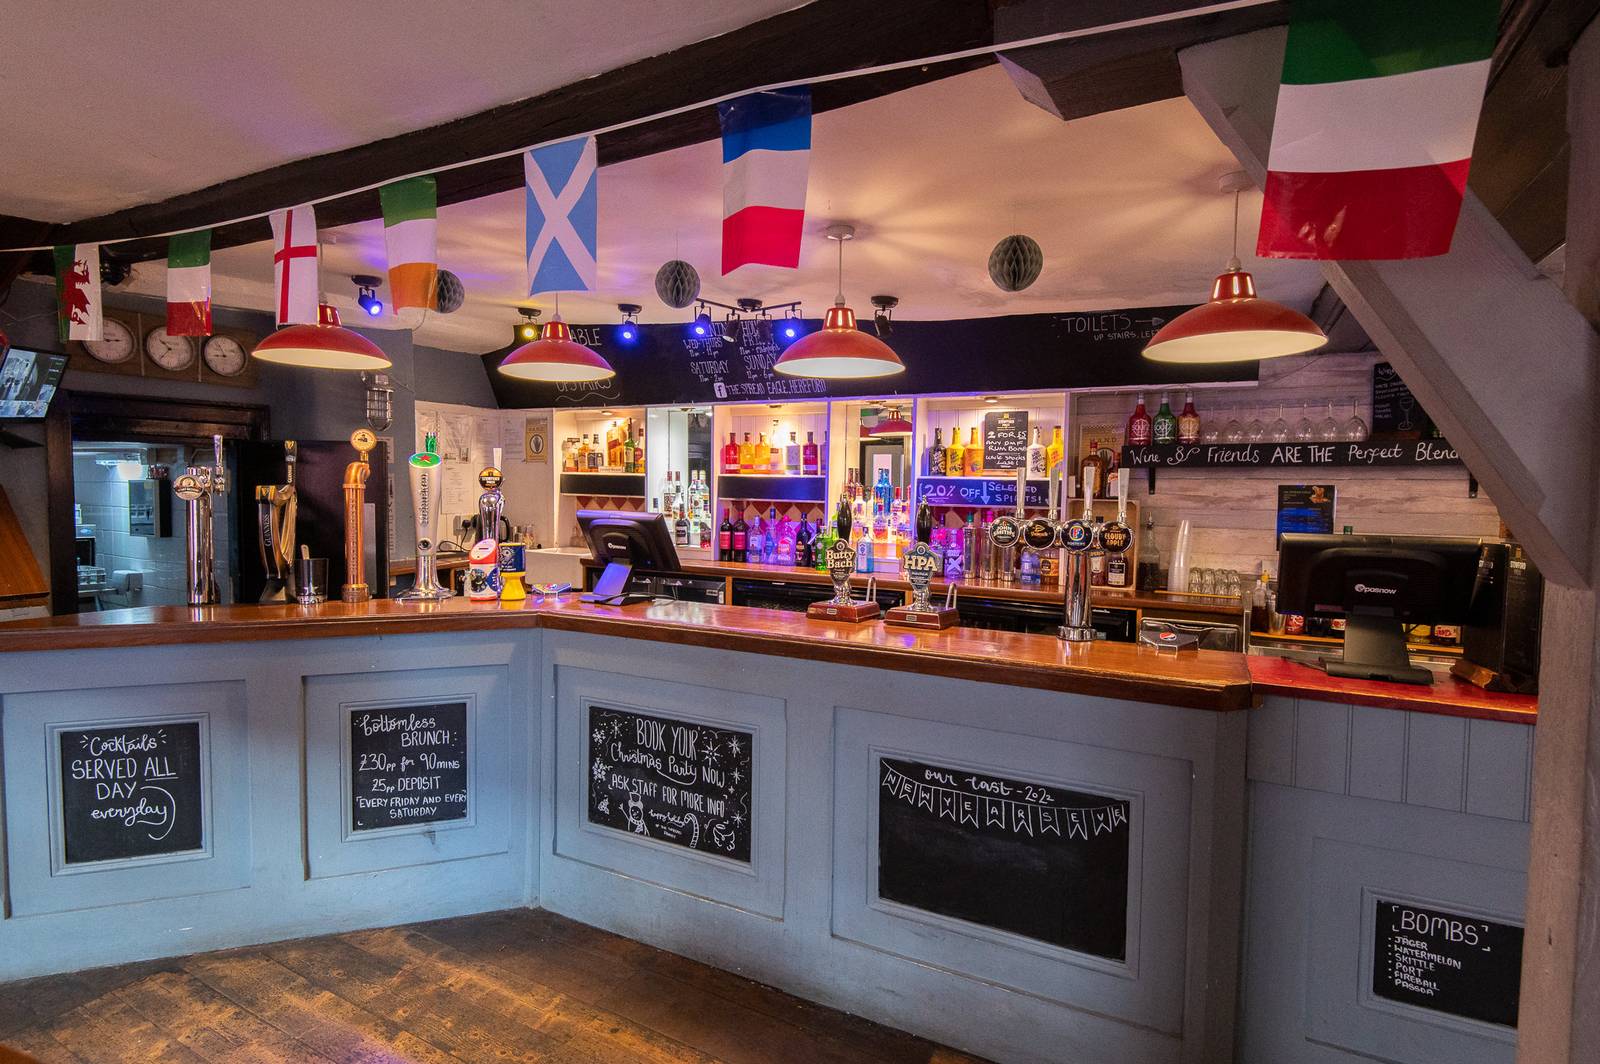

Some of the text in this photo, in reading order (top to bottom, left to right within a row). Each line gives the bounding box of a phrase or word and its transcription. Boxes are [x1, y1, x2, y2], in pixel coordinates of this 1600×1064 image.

[1061, 314, 1132, 333] TOILETS
[690, 360, 729, 374] SATURDAY
[744, 353, 777, 370] SUNDAY
[726, 384, 740, 395] THE
[740, 382, 765, 395] SPREAD
[789, 379, 826, 394] HEREFORD
[988, 431, 996, 439] 2
[1130, 450, 1160, 465] Wine
[1207, 444, 1260, 463] Friends
[1271, 446, 1302, 463] ARE
[1307, 445, 1335, 463] THE
[1348, 443, 1402, 464] Perfect
[925, 484, 980, 499] 20% OFF
[826, 549, 855, 560] Butty
[903, 555, 938, 571] HPA
[826, 558, 854, 569] Bach
[90, 734, 157, 756] Cocktails
[401, 730, 450, 747] BRUNCH
[636, 718, 698, 761] BOOK YOUR
[71, 757, 177, 779] SERVED ALL
[400, 756, 415, 772] for
[610, 741, 725, 788] Christmas Party NOW
[398, 775, 441, 792] DEPOSIT
[924, 769, 957, 786] our
[96, 781, 137, 800] DAY
[612, 773, 725, 818] ASK STAFF FOR MORE INFO
[359, 793, 467, 808] EVERY FRIDAY AND EVERY
[91, 797, 168, 827] everyday
[389, 806, 438, 819] SATURDAY
[1401, 910, 1479, 946] BOMBS
[1394, 944, 1462, 970] WATERMELON
[1395, 953, 1436, 972] SKITTLE
[1396, 963, 1424, 977] PORT
[1394, 971, 1440, 991] FIREBALL
